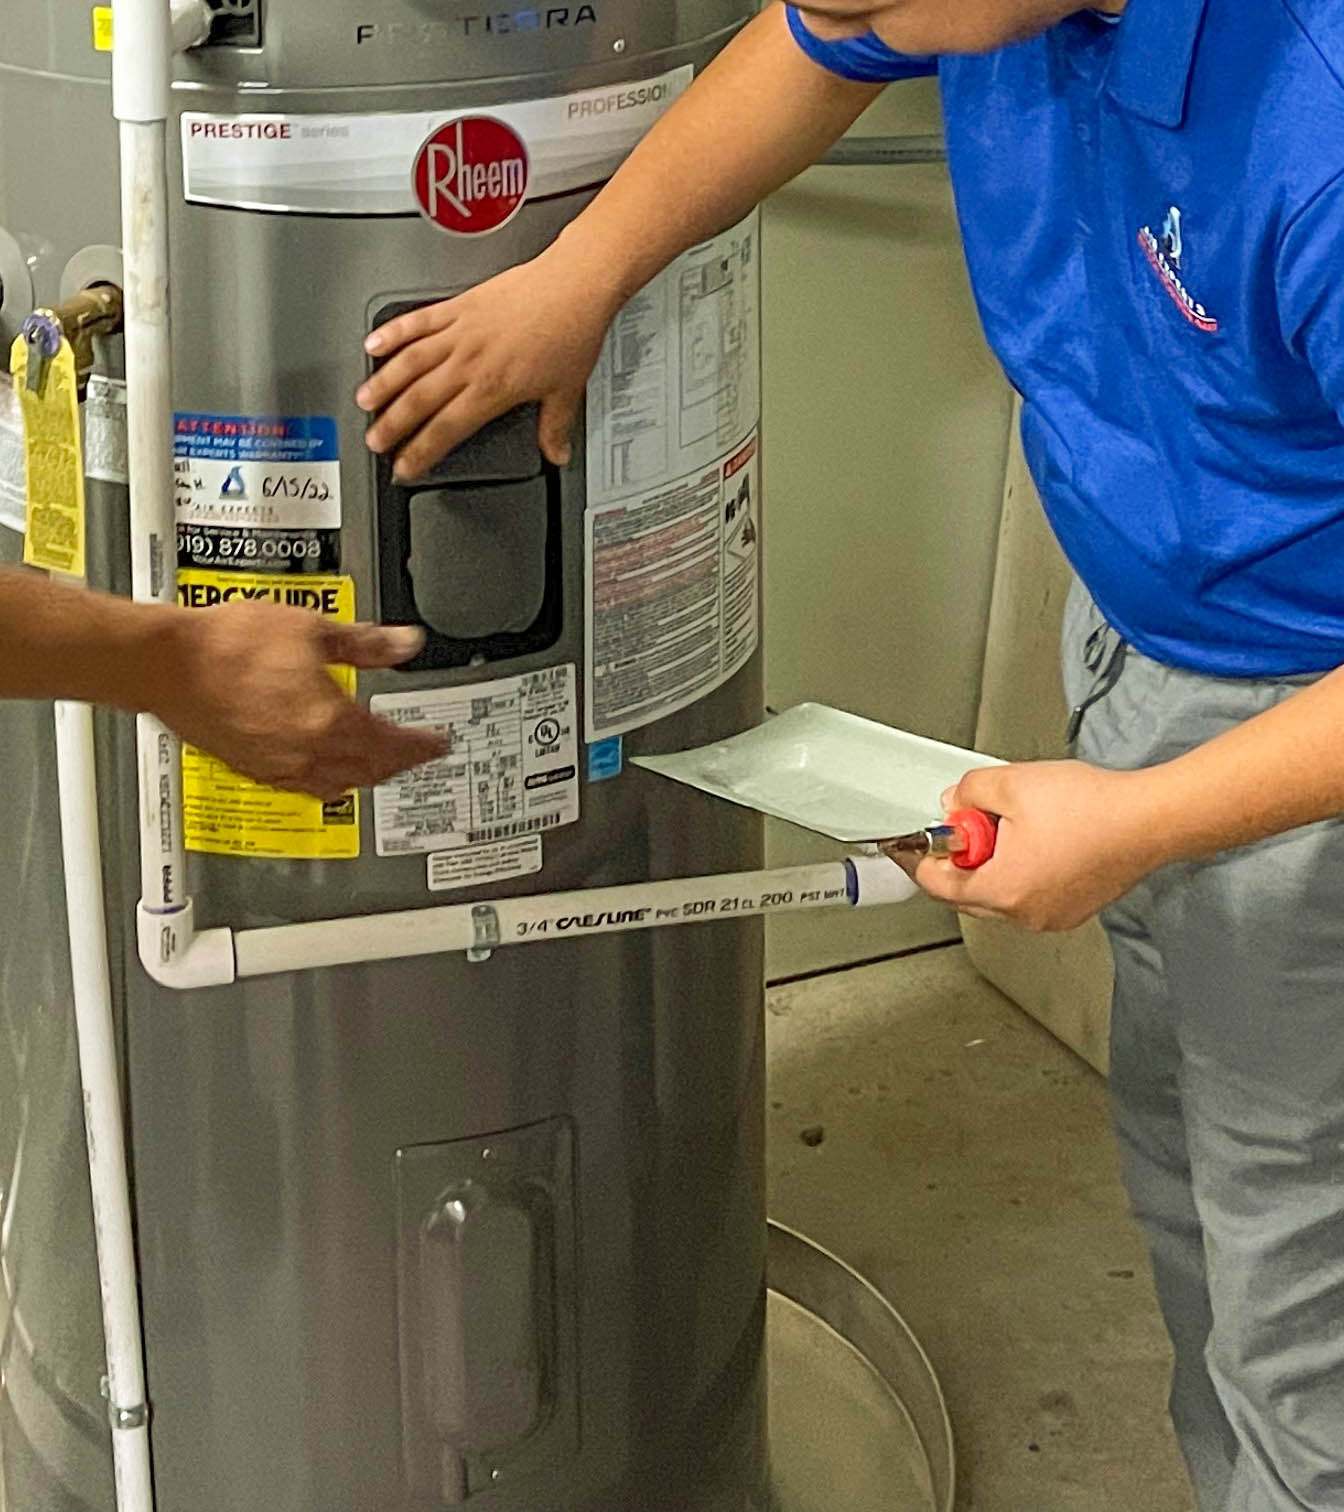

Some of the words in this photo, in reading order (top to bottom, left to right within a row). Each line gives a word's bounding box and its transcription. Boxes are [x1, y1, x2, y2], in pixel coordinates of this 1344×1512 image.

[190, 123, 293, 139] PRESTIGE
[427, 121, 524, 218] Rheem
[682, 899, 717, 917] SDR
[720, 896, 740, 913] 21
[759, 891, 794, 908] 200
